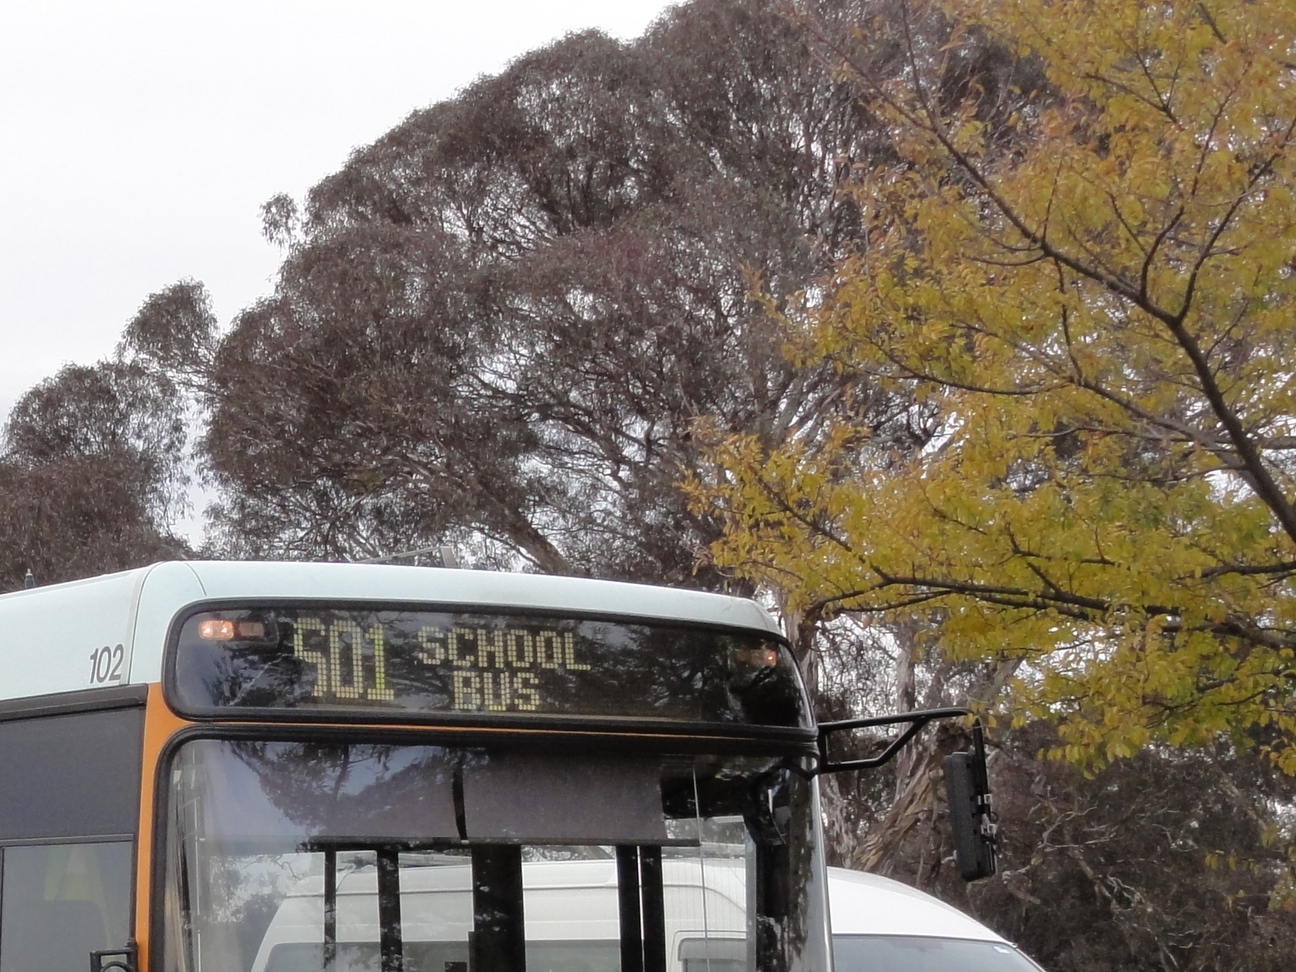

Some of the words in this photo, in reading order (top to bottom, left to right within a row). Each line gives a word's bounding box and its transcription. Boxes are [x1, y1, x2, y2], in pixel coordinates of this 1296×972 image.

[90, 644, 124, 684] 102
[293, 617, 395, 701] 501
[418, 625, 591, 671] SCHOOL
[454, 670, 539, 711] BUS
